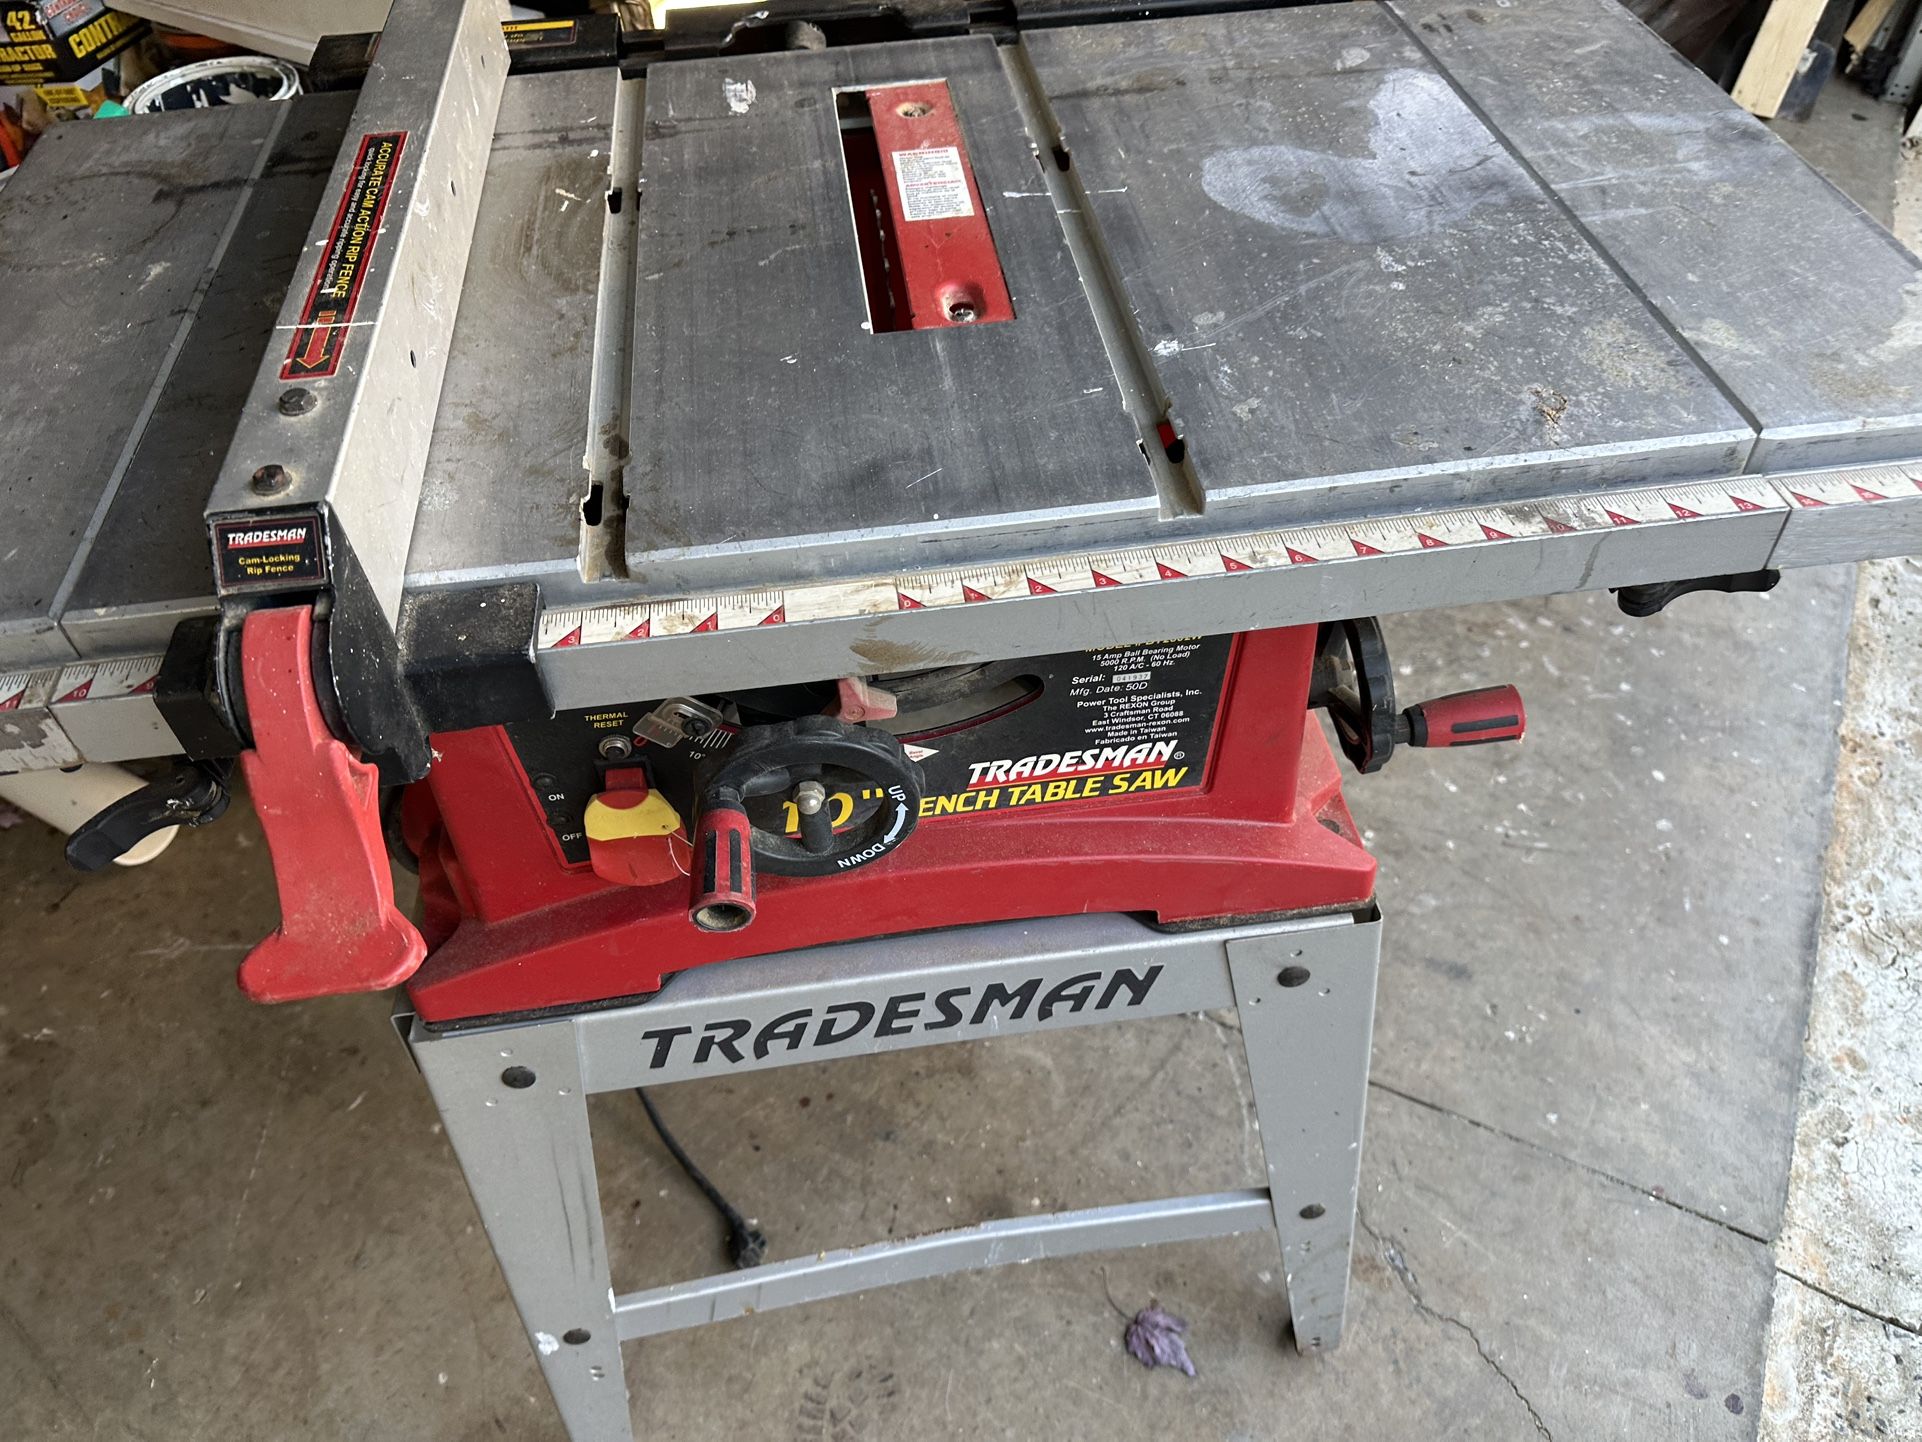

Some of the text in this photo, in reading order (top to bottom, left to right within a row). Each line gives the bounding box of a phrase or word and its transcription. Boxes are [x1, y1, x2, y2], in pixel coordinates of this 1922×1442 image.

[6, 11, 36, 30] 42
[352, 189, 361, 202] easy
[348, 202, 357, 212] and
[332, 142, 392, 298] ACCURATE CAM ACTION RIP FENCE
[330, 238, 345, 259] ripping
[227, 528, 306, 545] TRADESMAN
[1034, 585, 1043, 593] 2
[1164, 570, 1173, 578] 4
[1426, 538, 1434, 546] 8
[1676, 509, 1690, 518] 12
[1738, 502, 1752, 510] 13
[239, 554, 300, 566] Cam-Locking
[247, 564, 294, 576] Rip Fence
[568, 614, 780, 644] 3 2 1 0
[1100, 659, 1120, 667] 5000
[1121, 656, 1146, 664] R.P.M.
[1166, 651, 1190, 660] Load)
[1103, 653, 1122, 661] Amp
[1142, 647, 1174, 656] Bearing
[1114, 664, 1128, 672] 120
[1129, 662, 1144, 670] A/C
[1072, 674, 1106, 684] Serial:
[72, 688, 87, 698] 10
[1070, 682, 1148, 698] Mfg. Date: 50D
[1077, 700, 1106, 708] Power
[1108, 696, 1128, 705] Tool
[1130, 690, 1184, 702] Specialists,
[1120, 702, 1148, 710] REXON
[1151, 700, 1176, 708] Group
[584, 712, 629, 722] THERMAL
[1110, 708, 1150, 718] Craftsman
[1112, 716, 1146, 724] Windsor,
[594, 720, 624, 728] RESET
[1084, 718, 1190, 733] www.tradesman-rexon.com
[1095, 736, 1136, 745] Fabricado
[967, 739, 1178, 784] TRADESMAN
[548, 794, 564, 802] ON
[888, 784, 906, 802] UP
[918, 790, 1000, 816] ENCH
[1008, 776, 1104, 806] TABLE
[1108, 766, 1188, 794] SAW
[562, 832, 582, 842] OFF
[837, 842, 886, 868] DOWN
[641, 964, 1165, 1070] TRADESMAN
